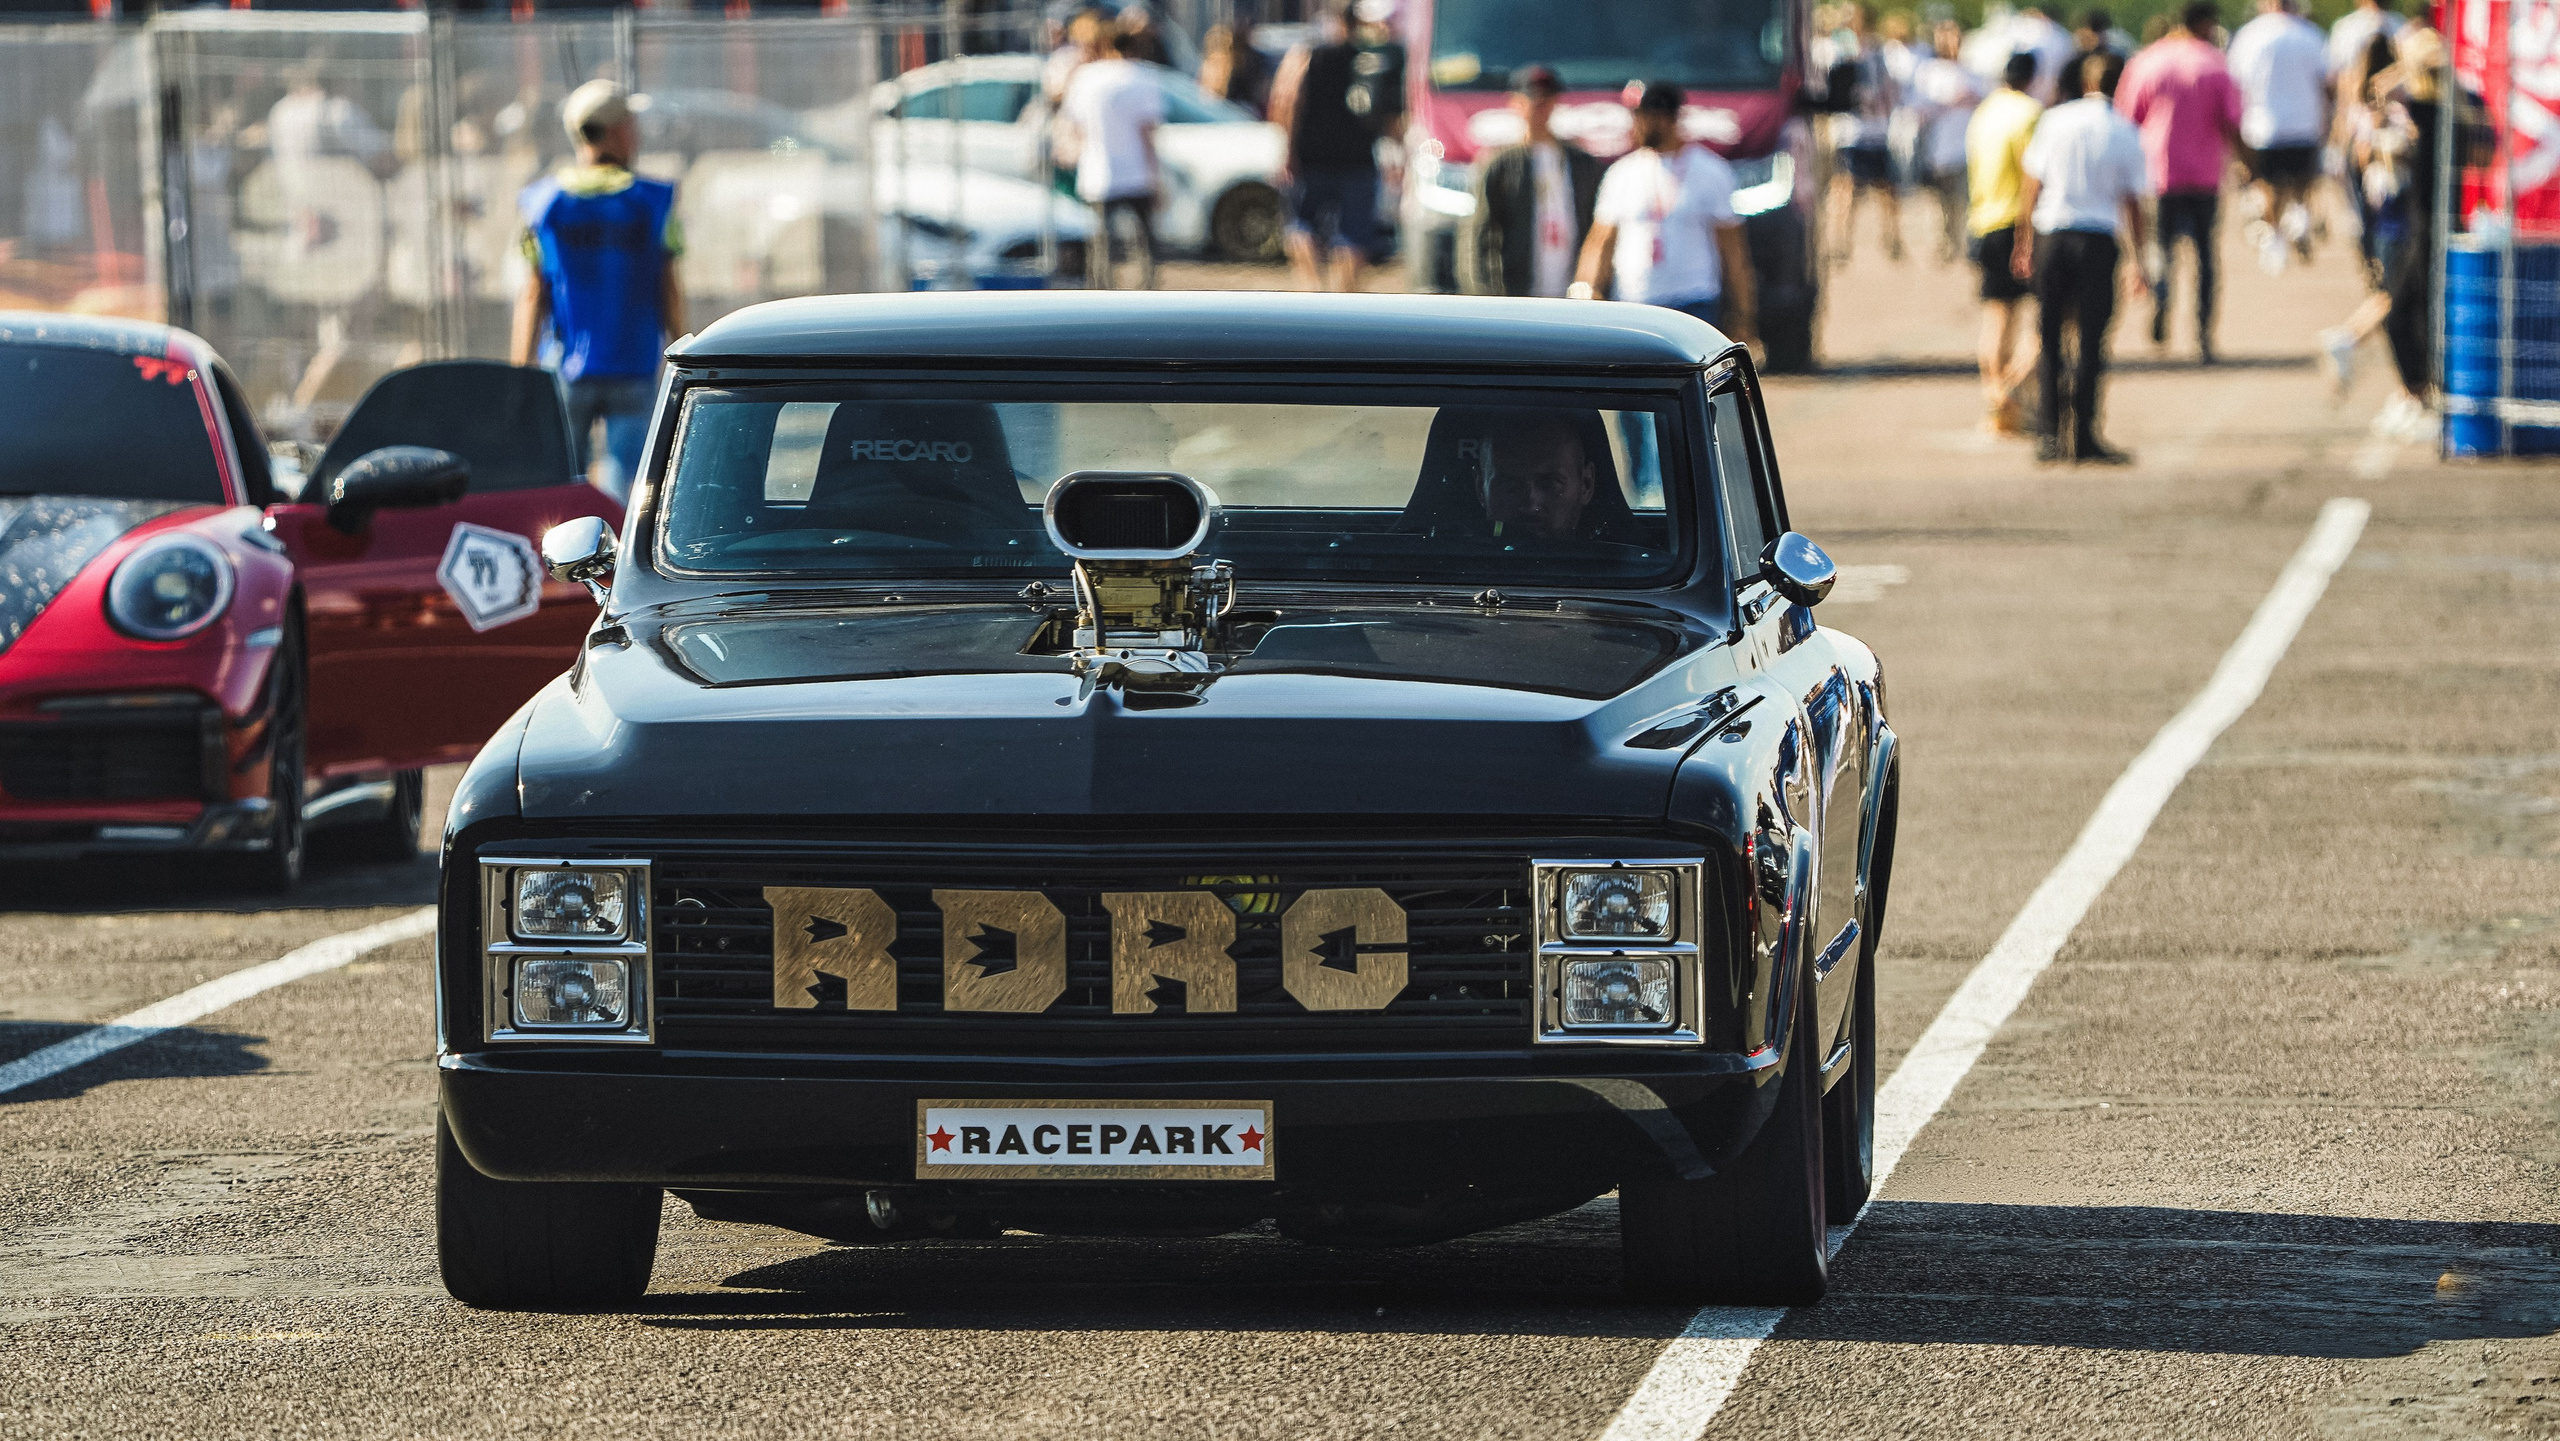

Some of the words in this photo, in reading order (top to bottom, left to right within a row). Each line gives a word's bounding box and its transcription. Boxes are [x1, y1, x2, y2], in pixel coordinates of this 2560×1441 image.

[851, 439, 973, 463] RECARO
[763, 886, 1408, 1014] RDRC
[959, 1123, 1235, 1156] RACEPARK
